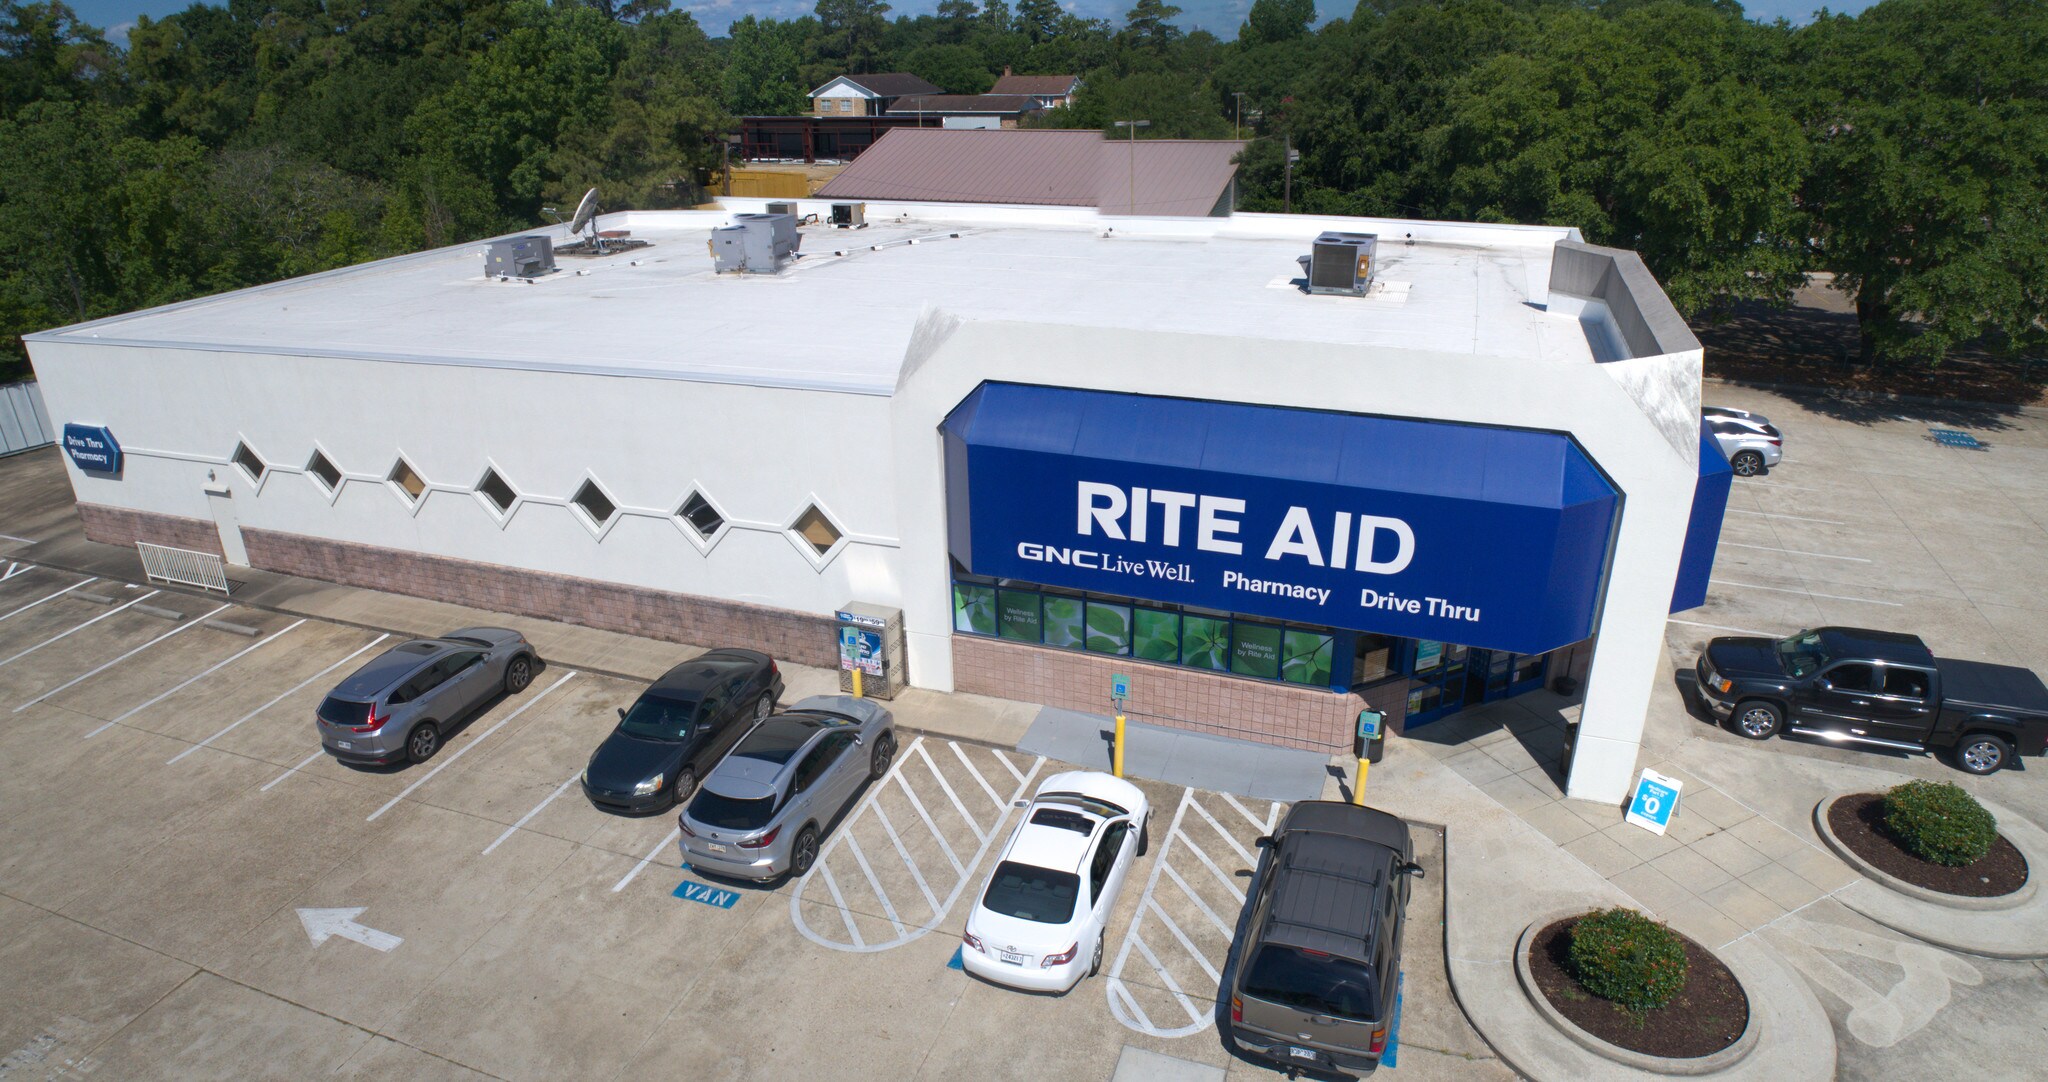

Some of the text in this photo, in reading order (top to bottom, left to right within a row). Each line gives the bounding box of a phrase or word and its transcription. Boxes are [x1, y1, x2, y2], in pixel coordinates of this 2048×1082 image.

[67, 435, 104, 449] Drive Thru
[71, 448, 107, 464] Pharmacy
[1078, 481, 1415, 574] RITE AID
[1018, 542, 1098, 568] GNC
[1224, 571, 1330, 605] Pharmacy
[1006, 607, 1034, 617] Wellness
[1361, 589, 1479, 622] Drive Thru
[1013, 615, 1025, 623] Rite
[1241, 641, 1273, 652] Wellness
[1248, 650, 1262, 658] Rite
[1263, 652, 1276, 660] Aid
[685, 884, 731, 906] VAN
